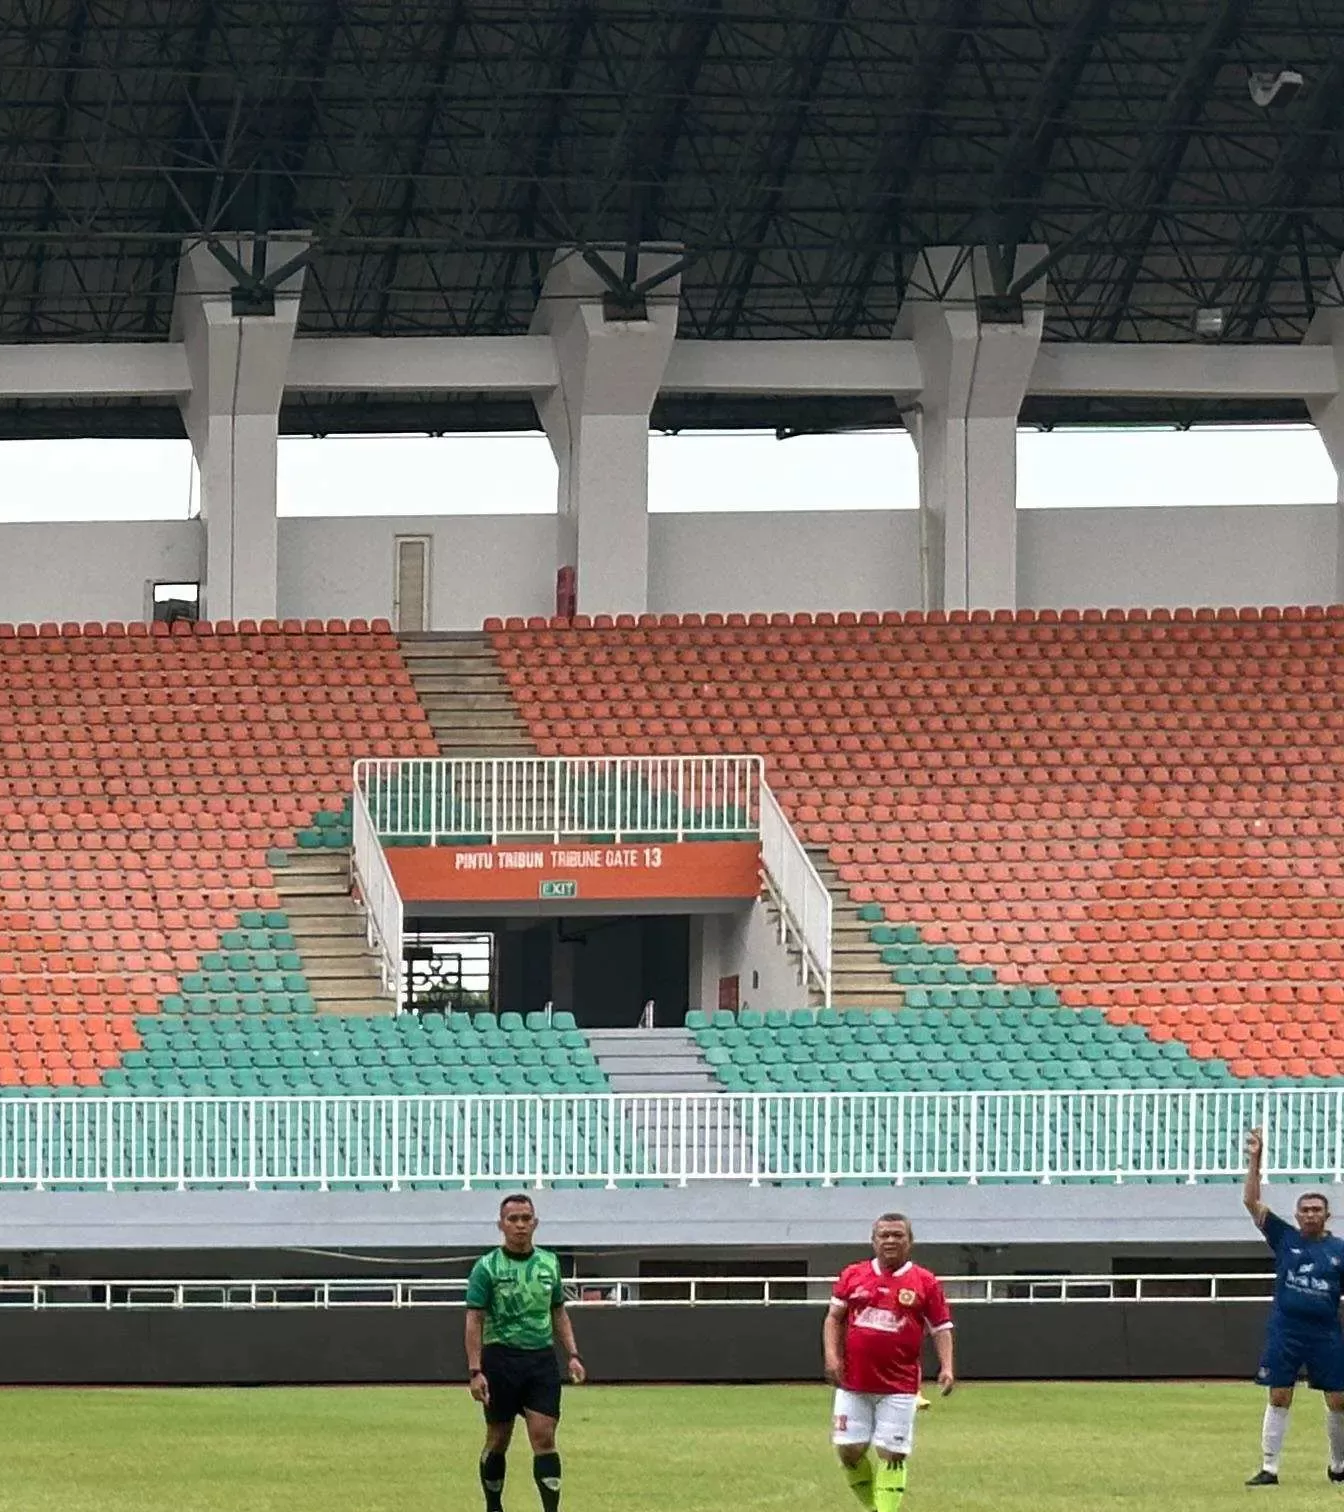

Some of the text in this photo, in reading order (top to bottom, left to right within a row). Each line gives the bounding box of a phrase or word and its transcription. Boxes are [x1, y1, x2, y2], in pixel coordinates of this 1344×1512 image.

[455, 847, 662, 870] PINTU TRIBUN TRIBUNE GATE 13
[542, 882, 573, 896] EXIT
